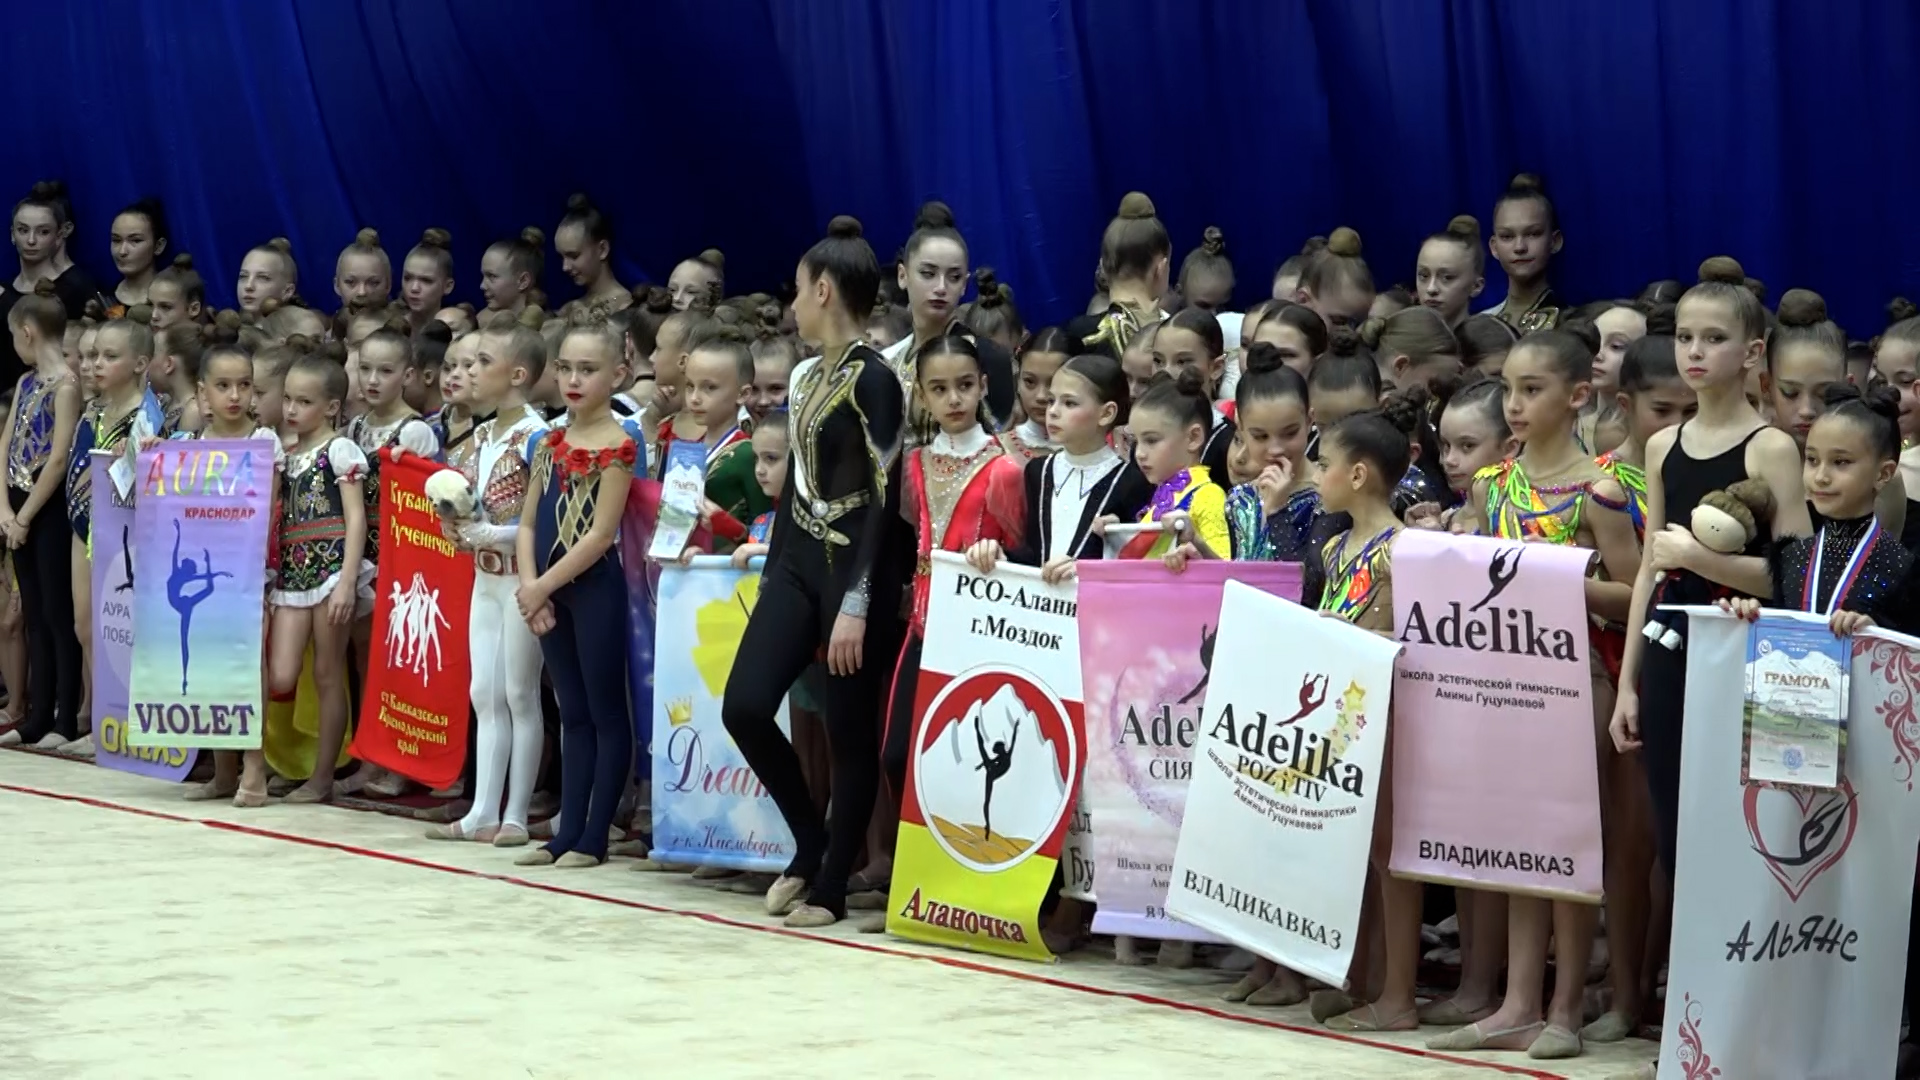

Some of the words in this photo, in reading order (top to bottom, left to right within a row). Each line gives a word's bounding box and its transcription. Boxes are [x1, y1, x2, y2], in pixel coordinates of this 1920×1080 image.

[144, 451, 257, 496] AURA
[185, 507, 256, 520] КРАСНОДАР
[102, 601, 130, 620] АУРА
[971, 615, 1063, 650] г.Моздок
[1401, 601, 1579, 662] Adelika
[1400, 669, 1434, 682] школа
[1438, 672, 1512, 690] эстетической
[1515, 681, 1580, 698] гимнастики
[1435, 687, 1473, 702] Амины
[1764, 671, 1830, 689] ГРАМОТА
[134, 703, 254, 736] VIOLET
[1207, 703, 1364, 797] Adelika
[1233, 788, 1266, 816] Амины
[1419, 840, 1574, 876] ВЛАДИКАВКАЗ
[900, 887, 1028, 944] Аланочка
[1183, 868, 1342, 951] ВЛАДИКАВКАЗ
